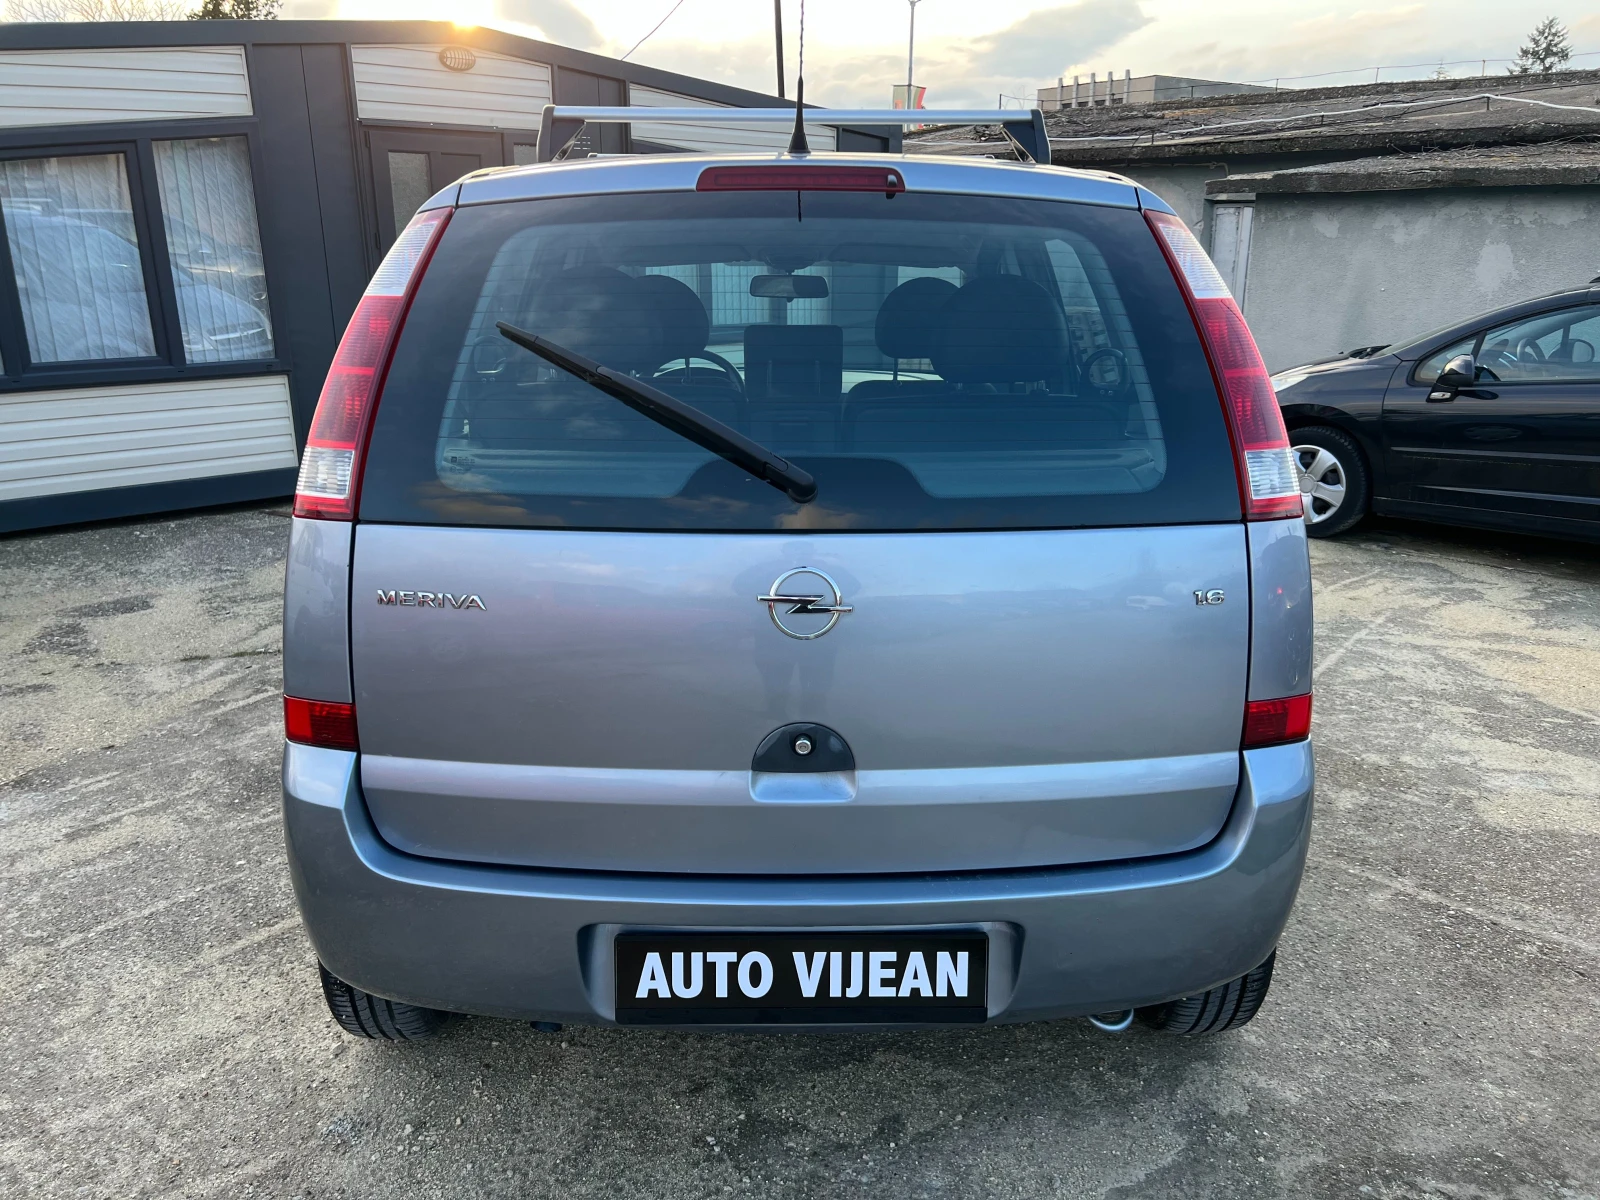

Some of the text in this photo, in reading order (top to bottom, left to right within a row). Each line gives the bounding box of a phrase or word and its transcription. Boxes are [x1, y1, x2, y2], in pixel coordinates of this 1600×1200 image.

[377, 589, 487, 611] MERIVA
[635, 951, 969, 998] AUTO VIJEAN
